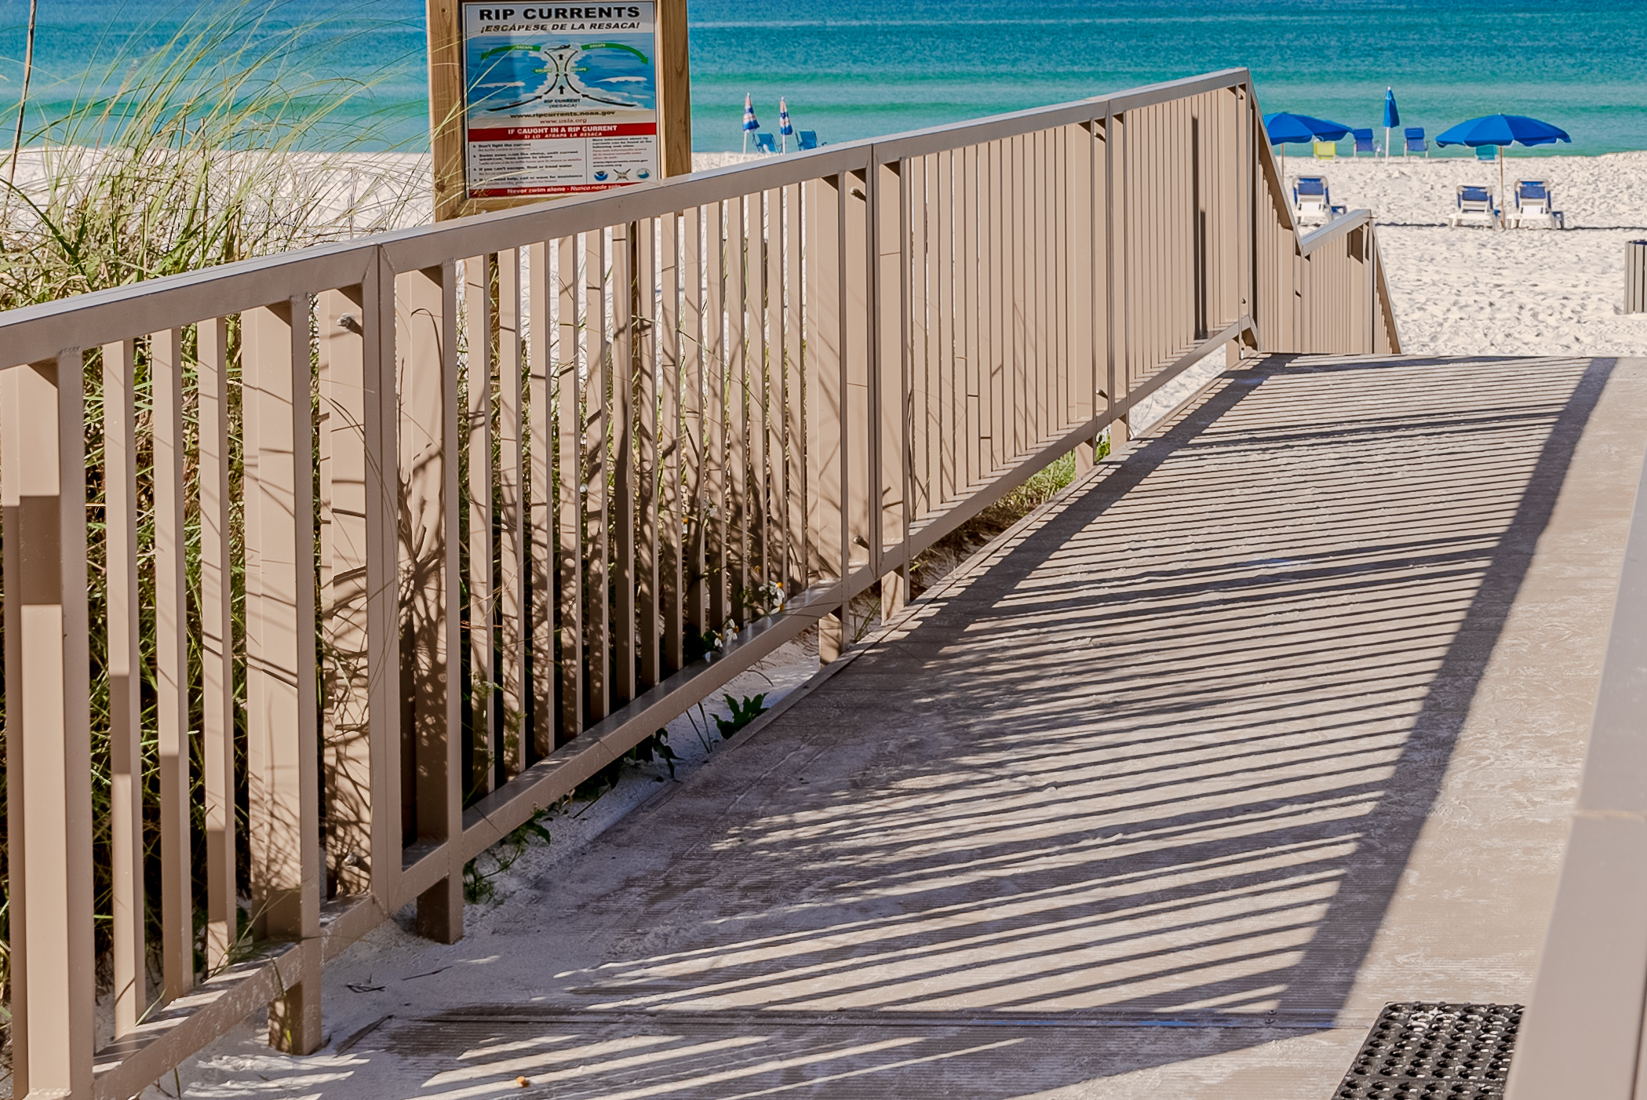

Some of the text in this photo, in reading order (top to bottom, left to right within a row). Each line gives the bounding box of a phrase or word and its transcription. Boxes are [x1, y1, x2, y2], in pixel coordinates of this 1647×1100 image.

[479, 7, 640, 20] RIP CURRENTS
[481, 23, 549, 33] ¡ESCÁPESE
[509, 110, 616, 118] www.ripcurrents.noaa.gov
